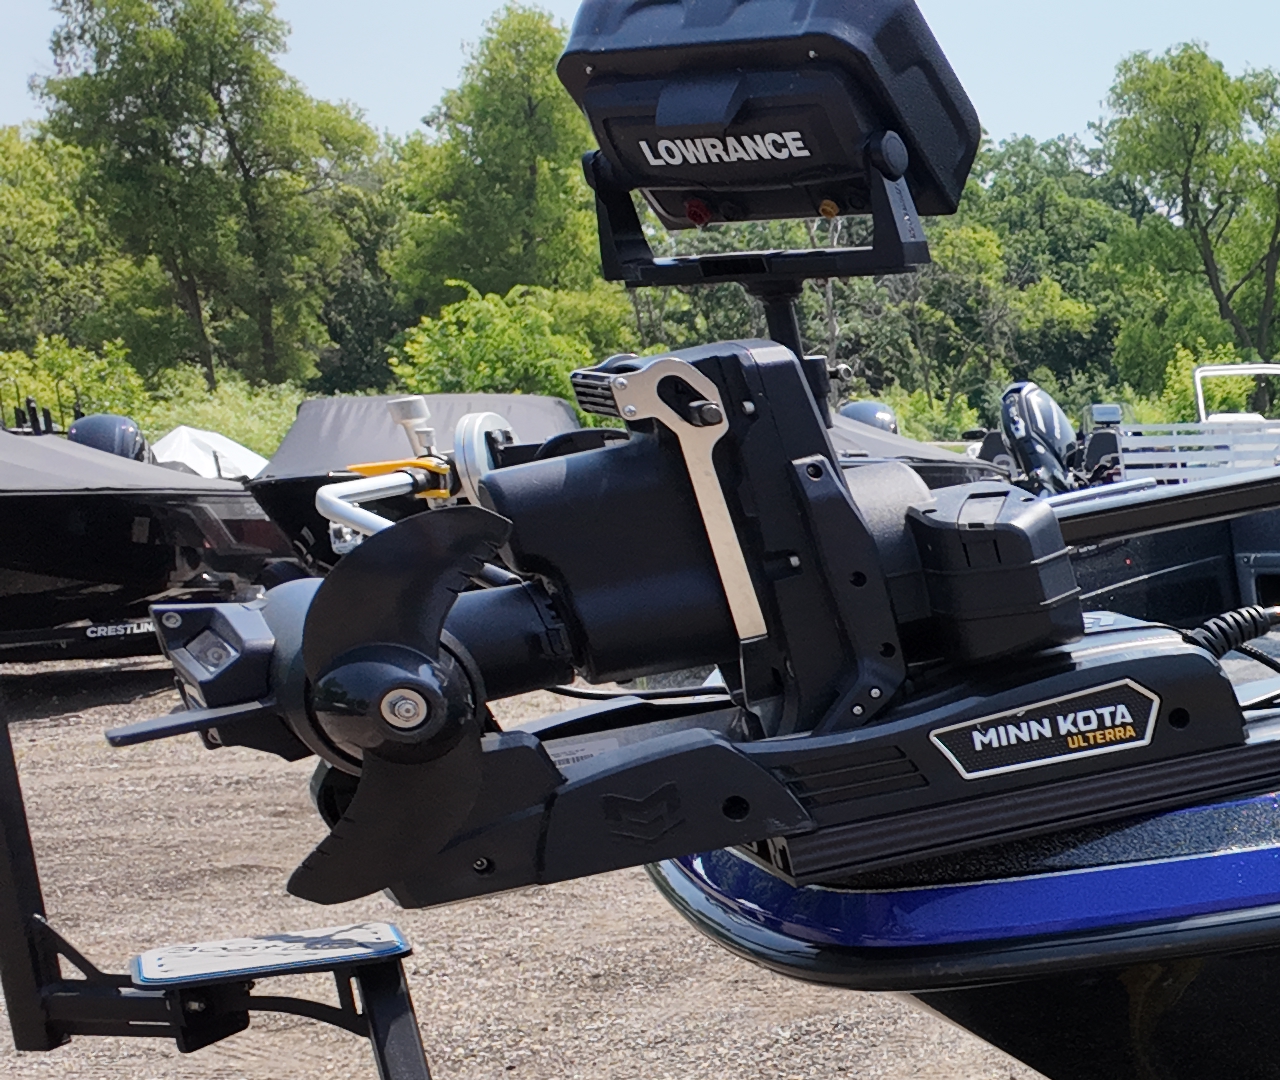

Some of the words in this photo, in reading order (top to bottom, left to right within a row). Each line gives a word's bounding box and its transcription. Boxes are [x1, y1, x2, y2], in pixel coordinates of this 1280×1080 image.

[639, 131, 811, 167] LOWRANCE
[972, 719, 1054, 751] MINN
[1057, 703, 1134, 735] KOTA
[1067, 724, 1137, 749] ULTERRA
